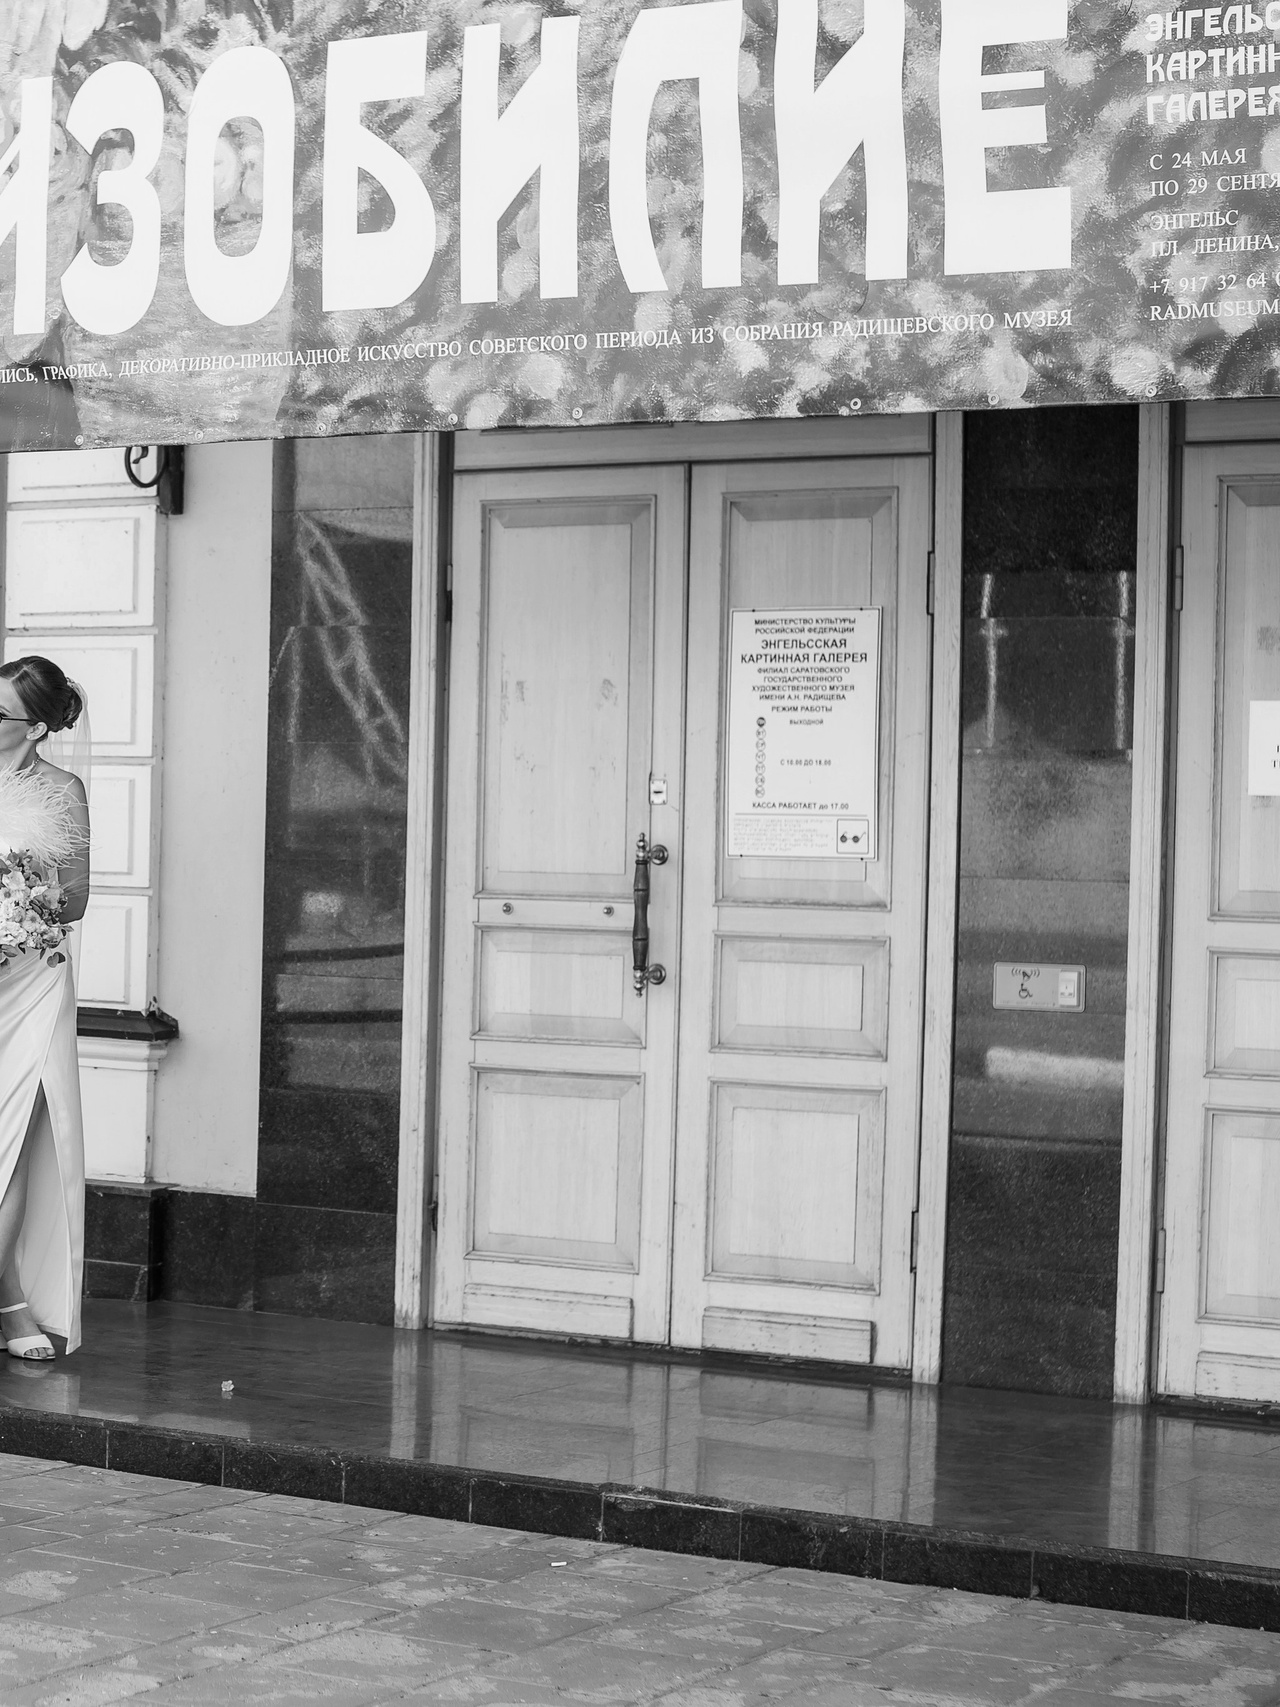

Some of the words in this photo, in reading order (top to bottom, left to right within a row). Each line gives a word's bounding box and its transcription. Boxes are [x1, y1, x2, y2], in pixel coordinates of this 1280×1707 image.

[1150, 154, 1163, 170] С
[1172, 152, 1191, 168] 24
[1201, 148, 1247, 167] МАЯ
[1150, 180, 1179, 197] ПО
[1187, 177, 1208, 194] 29
[1150, 209, 1239, 231] ЭНГЕЛЬС
[1151, 240, 1182, 257] ПЛ.
[1191, 234, 1279, 254] ЛЕНИНА,
[1150, 279, 1170, 294] +7
[1179, 276, 1208, 293] 917
[1217, 274, 1237, 291] 32
[1246, 272, 1267, 289] 64
[43, 361, 113, 382] ГРАФИКА,
[119, 347, 351, 378] ДЕКОРАТИВНО-ПРИКЛАДНОЕ
[357, 340, 462, 363] ИСКУССТВО
[469, 333, 588, 357] СОВЕТСКОГО
[595, 328, 682, 350] ПЕРИОДА
[690, 326, 715, 345] ИЗ
[722, 320, 823, 343] СОБРАНИЯ
[832, 313, 995, 339] РАДИЩЕВСКОГО
[1004, 308, 1073, 329] МУЗЕЯ
[754, 618, 813, 626] МИНИСТЕРСТВО
[815, 617, 856, 625] КУЛЬТУРЫ
[755, 627, 805, 635] РОССИЙСКОЙ
[807, 626, 855, 634] ФЕДЕРАЦИИ
[761, 638, 847, 650] ЭНГЕЛЬССКАЯ
[741, 653, 810, 664] КАРТИННАЯ
[813, 652, 867, 663] ГАЛЕРЕЯ
[757, 667, 789, 675] ФИЛИАЛ
[763, 675, 843, 684] ГОСУДАРСТВЕННОГО
[752, 684, 827, 693] ХУДОЖЕСТВЕННОГО
[829, 684, 855, 692] МУЗЕЯ
[759, 693, 786, 701] ИМЕНИ
[803, 693, 847, 702] РАДИЩЕВА
[800, 705, 833, 713] РАБОТЫ
